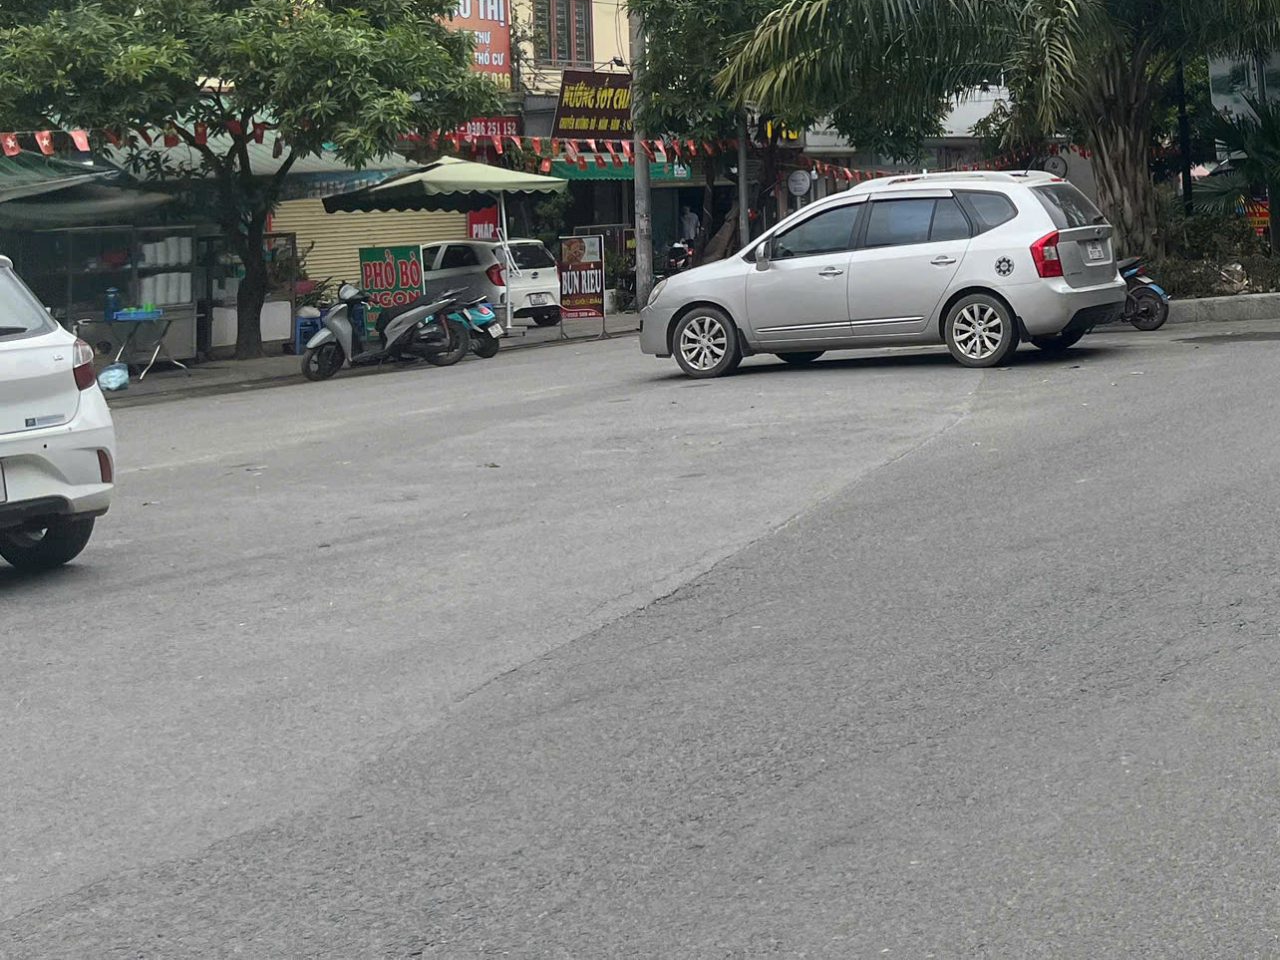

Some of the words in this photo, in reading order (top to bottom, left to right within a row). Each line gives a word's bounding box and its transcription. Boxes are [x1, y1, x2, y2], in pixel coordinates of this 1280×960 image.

[503, 121, 517, 135] 152
[362, 249, 396, 290] PHỞ
[398, 251, 422, 288] BÒ
[562, 264, 580, 295] BÚN
